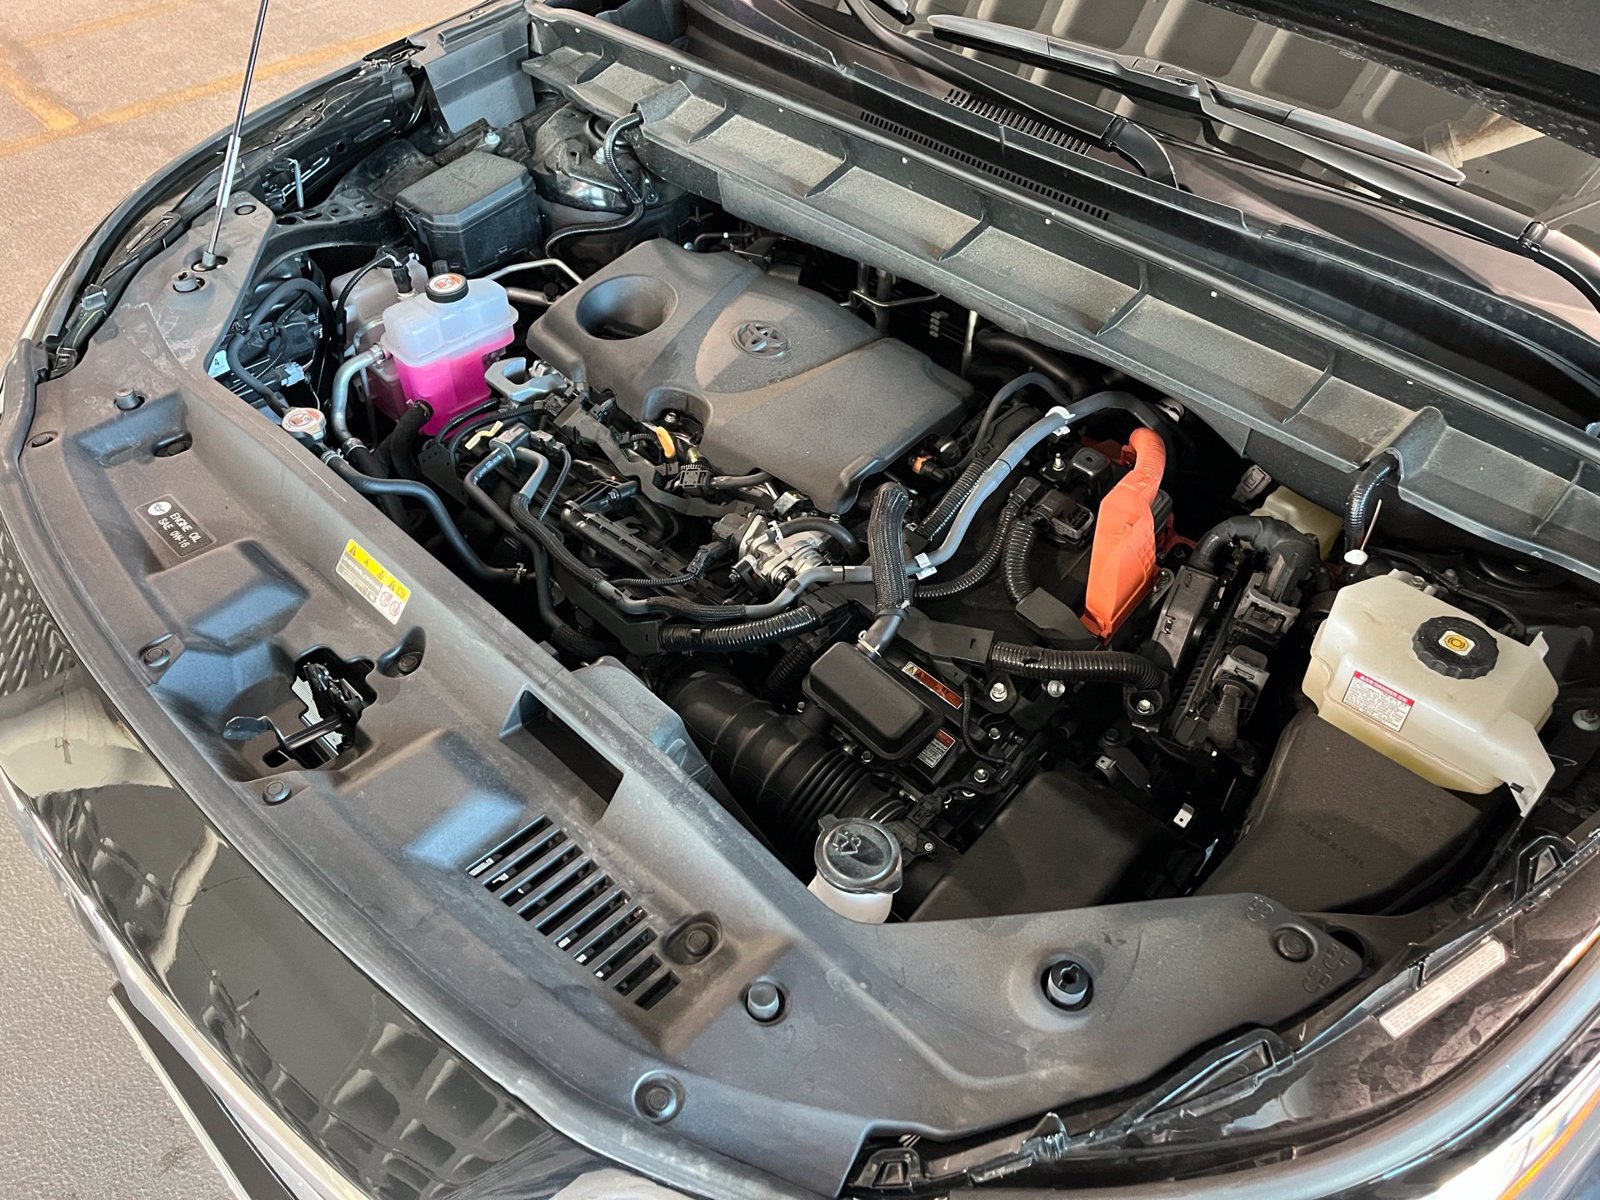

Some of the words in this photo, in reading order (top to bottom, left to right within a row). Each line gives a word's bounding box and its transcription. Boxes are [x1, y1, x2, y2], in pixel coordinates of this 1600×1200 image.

[158, 518, 174, 531] SAE
[169, 530, 191, 548] 0W-16
[170, 512, 193, 532] ENGINE
[189, 532, 202, 543] OIL
[1373, 681, 1398, 698] DANGER
